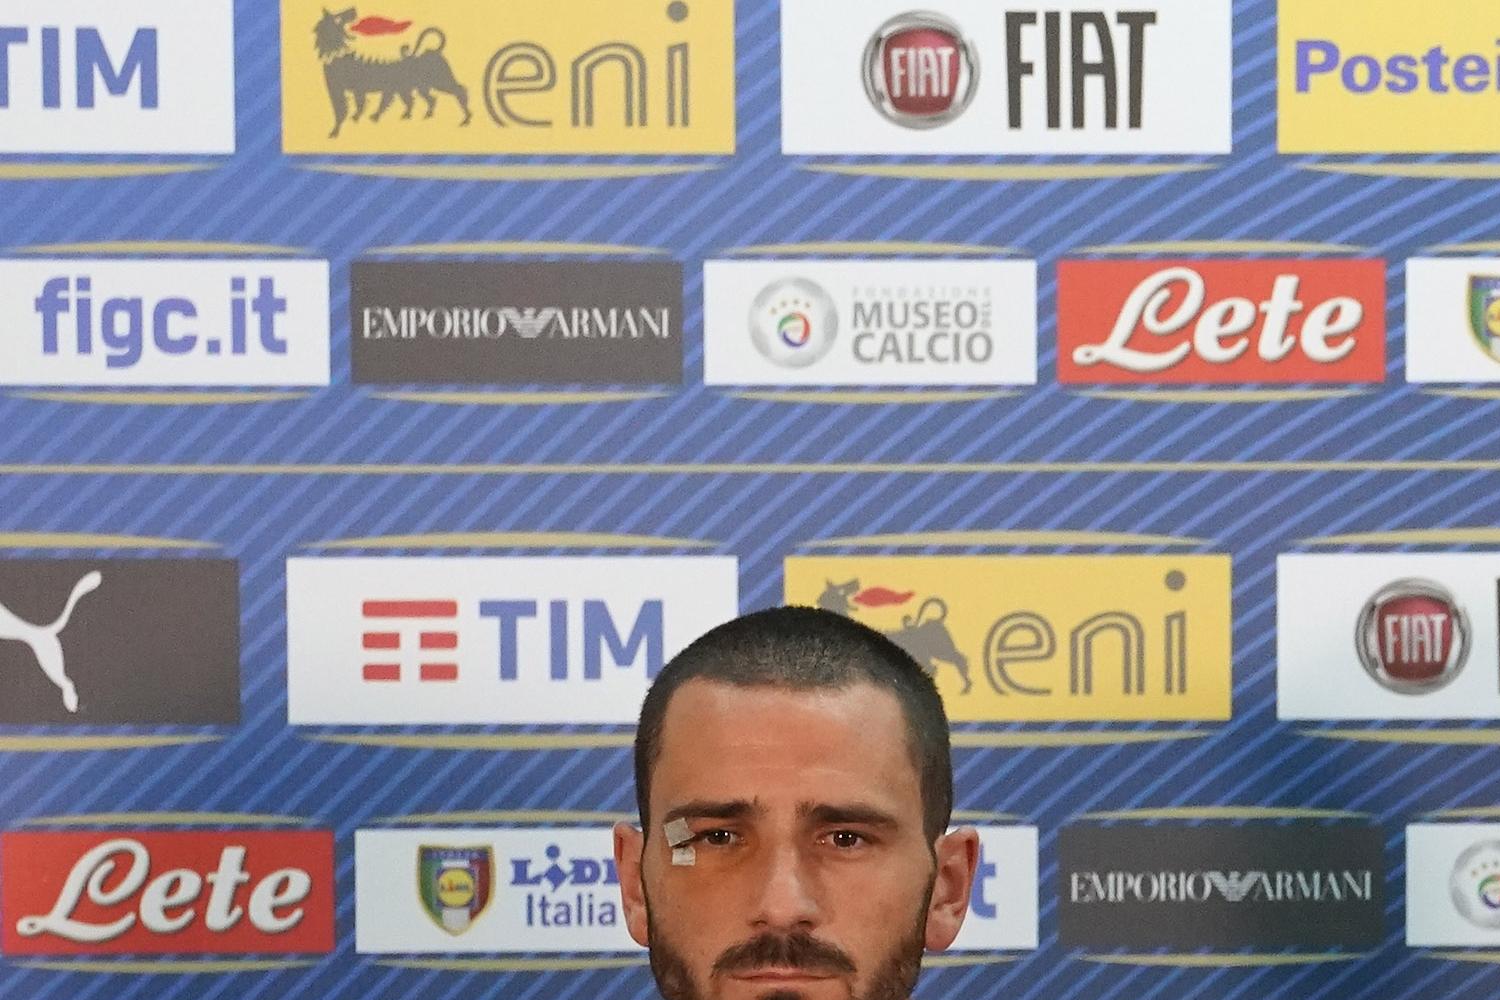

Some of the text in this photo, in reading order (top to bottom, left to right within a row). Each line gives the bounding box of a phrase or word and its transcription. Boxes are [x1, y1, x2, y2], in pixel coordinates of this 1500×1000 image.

[0, 26, 158, 109] TIM
[483, 0, 689, 128] eni
[891, 47, 955, 98] FIAT
[1005, 11, 1156, 130] FIAT
[35, 277, 287, 369] figc.it
[363, 307, 670, 339] EMPORIO ARMANI
[852, 332, 993, 363] CALCIO
[853, 301, 978, 329] MUSEO
[1073, 267, 1363, 371] Lete
[479, 599, 663, 680] TIM
[983, 570, 1187, 696] eni
[1384, 613, 1448, 663] FIAT
[16, 838, 311, 941] Lete
[526, 893, 616, 927] Italia
[1071, 870, 1373, 903] EMPORIO ARMANI
